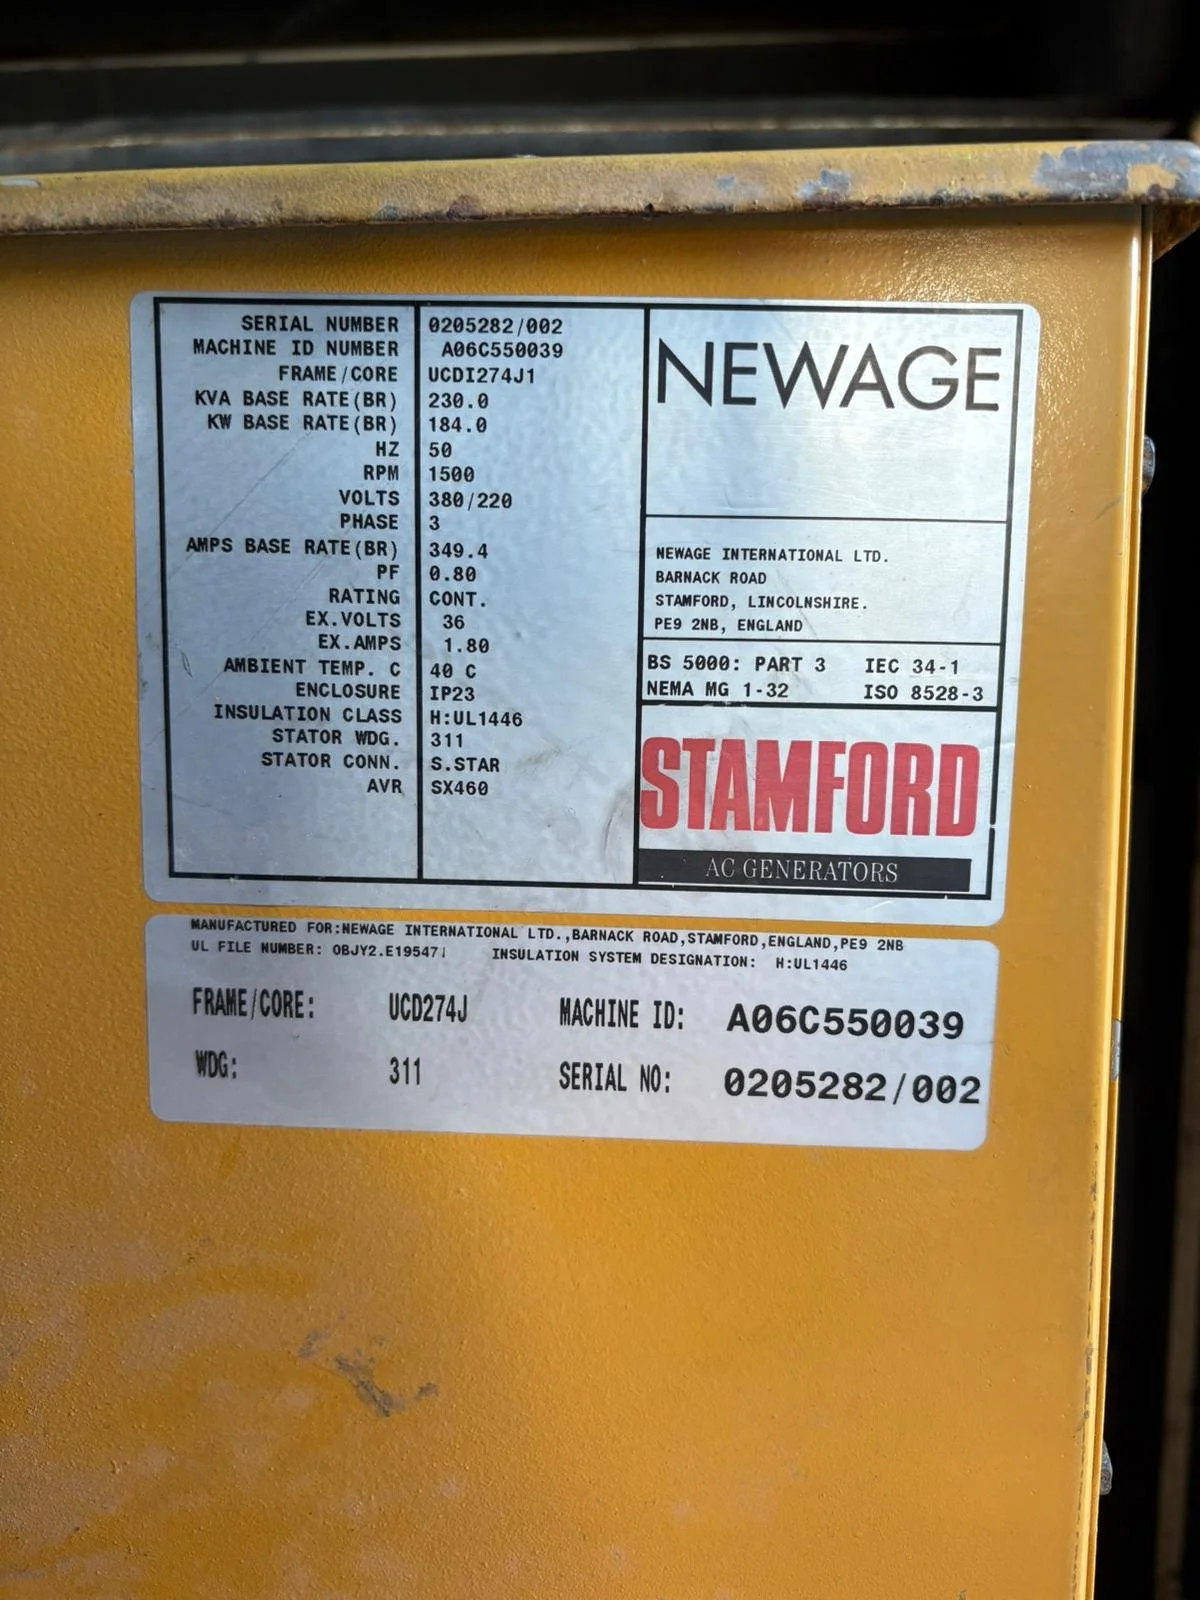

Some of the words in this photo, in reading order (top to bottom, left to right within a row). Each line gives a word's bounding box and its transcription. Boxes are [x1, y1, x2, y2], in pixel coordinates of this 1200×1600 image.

[241, 316, 313, 332] SERIAL
[326, 317, 398, 332] NUMBER
[429, 317, 563, 337] 0205282/002
[193, 339, 276, 355] MACHINE
[292, 341, 314, 356] ID
[327, 341, 398, 356] NUMBER
[442, 342, 563, 357] A06C550039
[279, 365, 398, 384] FRAME/CORE
[429, 367, 535, 383] UCDI274J1
[658, 338, 1002, 411] NEWAGE
[195, 390, 231, 406] KVA
[243, 391, 289, 407] BASE
[303, 392, 397, 411] RATE(BR)
[429, 393, 488, 408] 230.0
[208, 414, 231, 430] KW
[243, 415, 289, 430] BASE
[303, 416, 397, 435] RATE(BR)
[429, 417, 487, 432] 184.0
[376, 441, 399, 457] HZ
[429, 442, 452, 458] 50
[364, 465, 399, 480] RPM
[429, 467, 474, 482] 1500
[339, 490, 400, 506] VOLTS
[429, 492, 512, 510] 380/220
[340, 513, 398, 530] PHASE
[429, 516, 440, 531] 3
[186, 538, 232, 553] AMPS
[246, 539, 290, 554] BASE
[305, 540, 397, 559] RATE(BR)
[429, 543, 488, 558] 349.4
[656, 548, 711, 560] NEWAGE
[722, 548, 843, 562] INTERNATIONAL
[853, 550, 889, 563] LTD.
[377, 565, 400, 580] PF
[430, 566, 476, 581] 0.80
[656, 571, 720, 584] BARNACK
[730, 572, 767, 584] ROAD
[329, 588, 400, 605] RATING
[429, 591, 486, 607] CONT.
[655, 595, 737, 610] STAMFORD,
[748, 596, 868, 610] LINCOLNSHIRE.
[306, 611, 401, 628] EX.VOLTS
[443, 615, 464, 629] 36
[654, 618, 682, 631] PE9
[692, 619, 727, 633] 2NB,
[737, 619, 803, 632] ENGLAND
[318, 634, 401, 651] EX.AMPS
[444, 638, 489, 653] 1.80
[224, 658, 307, 674] AMBIENT
[319, 660, 374, 676] TEMP.
[390, 662, 401, 676] C
[648, 654, 671, 669] BS
[682, 655, 741, 671] 5000:
[755, 656, 802, 672] PART
[815, 658, 826, 672] 3
[865, 659, 899, 674] IEC
[912, 660, 959, 675] 34-1
[430, 664, 453, 679] 40
[466, 664, 476, 679] C
[296, 683, 401, 699] ENCLOSURE
[430, 687, 475, 702] IP23
[647, 681, 694, 696] NEMA
[706, 682, 728, 697] MG
[743, 683, 789, 698] 1-32
[864, 685, 898, 700] ISO
[911, 686, 984, 701] 8528-3
[214, 704, 331, 722] INSULATION
[343, 707, 402, 723] CLASS
[430, 711, 522, 726] H:UL1446
[272, 729, 342, 744] STATOR
[355, 731, 399, 746] WDG.
[431, 733, 463, 748] 311
[261, 752, 331, 768] STATOR
[343, 754, 399, 769] CONN.
[431, 757, 500, 772] S.STAR
[367, 779, 402, 794] AVR
[431, 781, 488, 796] SX460
[641, 737, 980, 837] STAMFORD
[705, 857, 735, 878] AC
[743, 859, 898, 882] GENERATORS
[191, 919, 296, 933] MANUFACTURED
[307, 922, 394, 936] FOR:NEWAGE
[405, 924, 518, 938] INTERNATIONAL
[528, 928, 634, 942] LTD.,BARNACK
[642, 929, 868, 951] ROAD,STAMFORD,ENGLAND,PE9
[877, 938, 904, 951] 2NB
[191, 941, 209, 952] UL
[218, 941, 251, 953] FILE
[261, 943, 322, 955] NUMBER:
[492, 948, 579, 962] INSULATION
[589, 951, 642, 964] SYSTEM
[651, 952, 756, 968] DESIGNATION:
[776, 958, 848, 971] H:UL1446
[192, 987, 316, 1020] FRAME/CORE:
[389, 993, 468, 1024] UCD274J
[559, 997, 641, 1030] MACHINE
[653, 998, 686, 1031] ID:
[726, 1003, 964, 1040] A06C550039
[194, 1049, 238, 1080] WDG:
[389, 1057, 422, 1087] 311
[559, 1061, 627, 1092] SERIAL
[639, 1064, 672, 1094] NO:
[723, 1069, 981, 1106] 0205282/002
